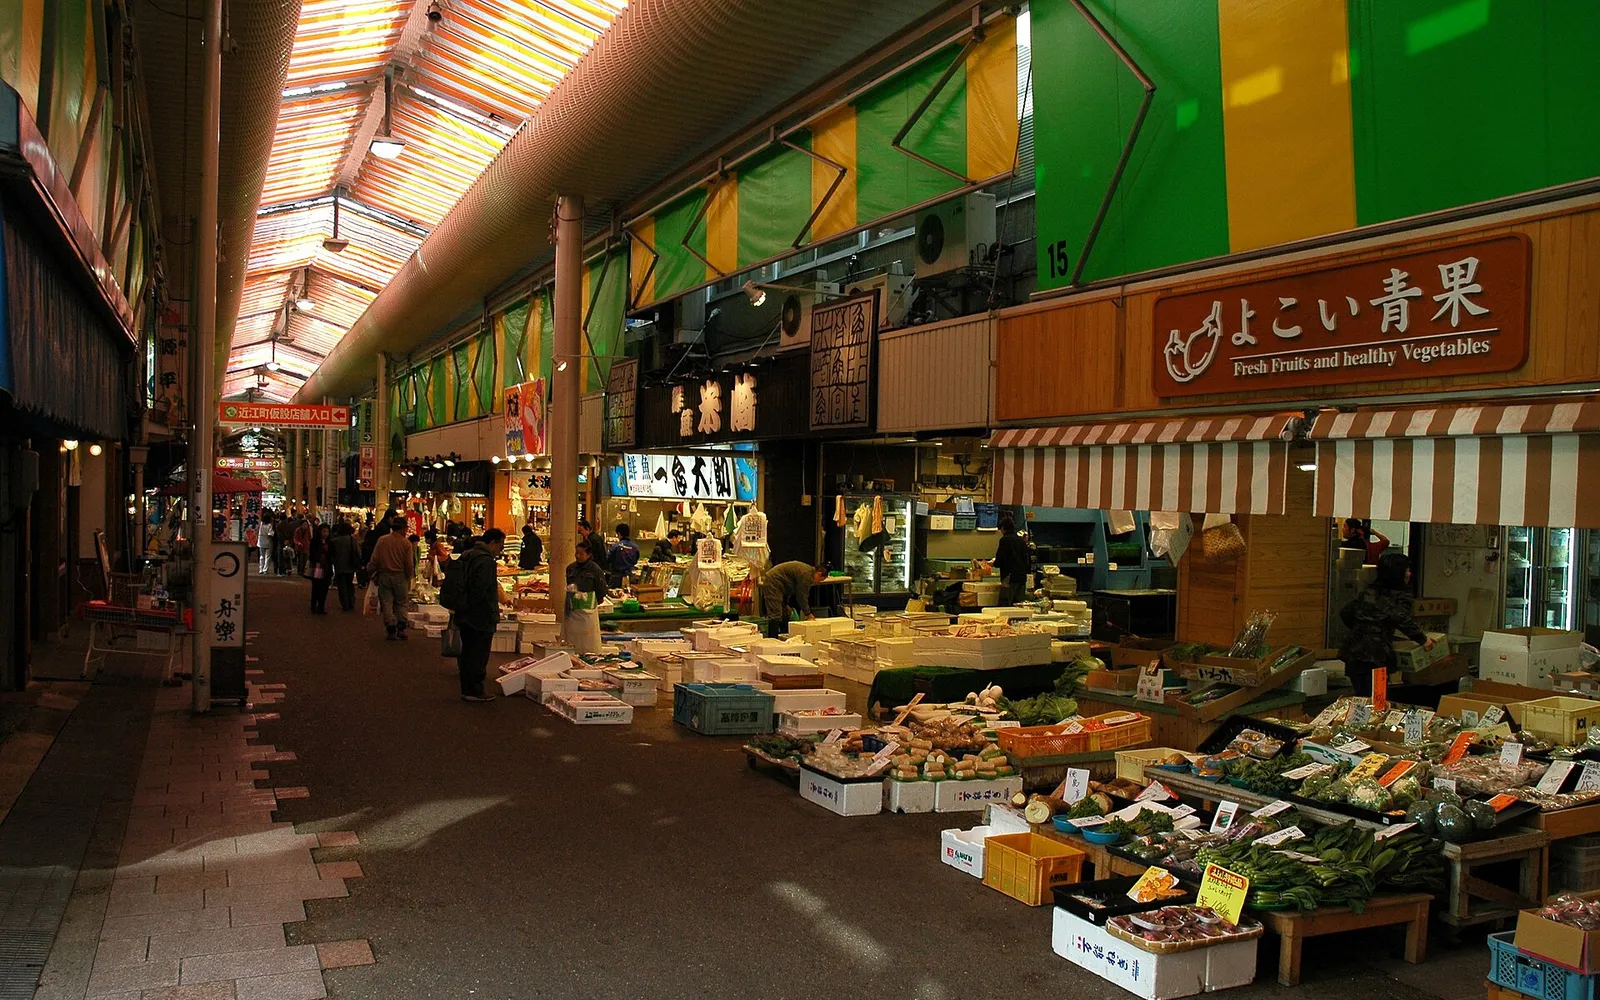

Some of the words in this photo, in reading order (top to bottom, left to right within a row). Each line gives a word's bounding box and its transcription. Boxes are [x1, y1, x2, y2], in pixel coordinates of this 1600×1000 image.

[1048, 240, 1068, 278] 15
[1231, 256, 1490, 346] よこい青果
[1233, 358, 1268, 376] Fresh
[1271, 357, 1310, 373] Fruits
[1313, 352, 1339, 369] and
[1342, 347, 1397, 367] healthy
[1401, 337, 1490, 363] Vegetables
[238, 406, 330, 421] 近江町仮設店舗入口
[1083, 936, 1129, 971] 万能ねぎ
